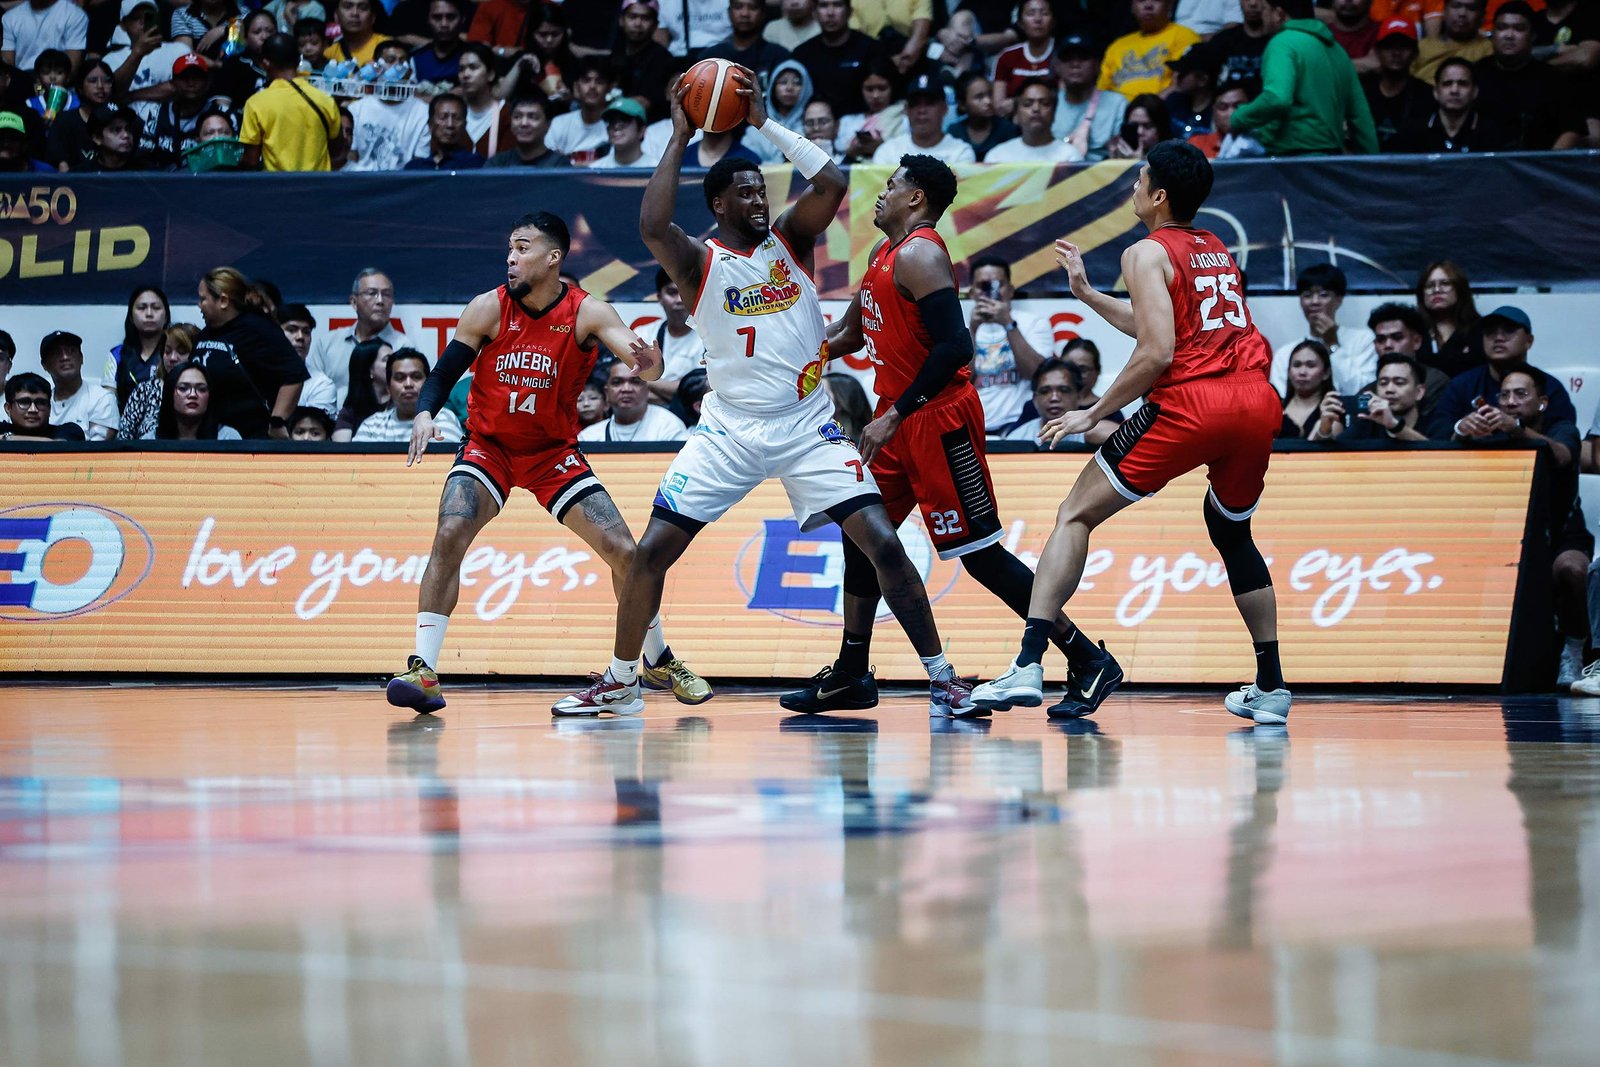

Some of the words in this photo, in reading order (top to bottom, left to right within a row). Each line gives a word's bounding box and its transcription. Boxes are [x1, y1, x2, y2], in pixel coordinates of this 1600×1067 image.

[727, 287, 764, 313] Rain
[747, 304, 770, 314] ELASTO
[1194, 273, 1247, 331] 25
[511, 343, 552, 354] BARANGAY
[736, 325, 756, 358] 7
[495, 351, 558, 379] GINEBRA
[498, 371, 519, 386] SAN
[1569, 376, 1583, 393] 19
[508, 391, 537, 415] 14
[554, 454, 581, 474] 14
[844, 459, 864, 482] 7
[930, 509, 963, 535] 32
[181, 516, 296, 588] love
[459, 546, 598, 621] eyes.
[1115, 550, 1273, 627] you
[1290, 547, 1444, 628] eyes.
